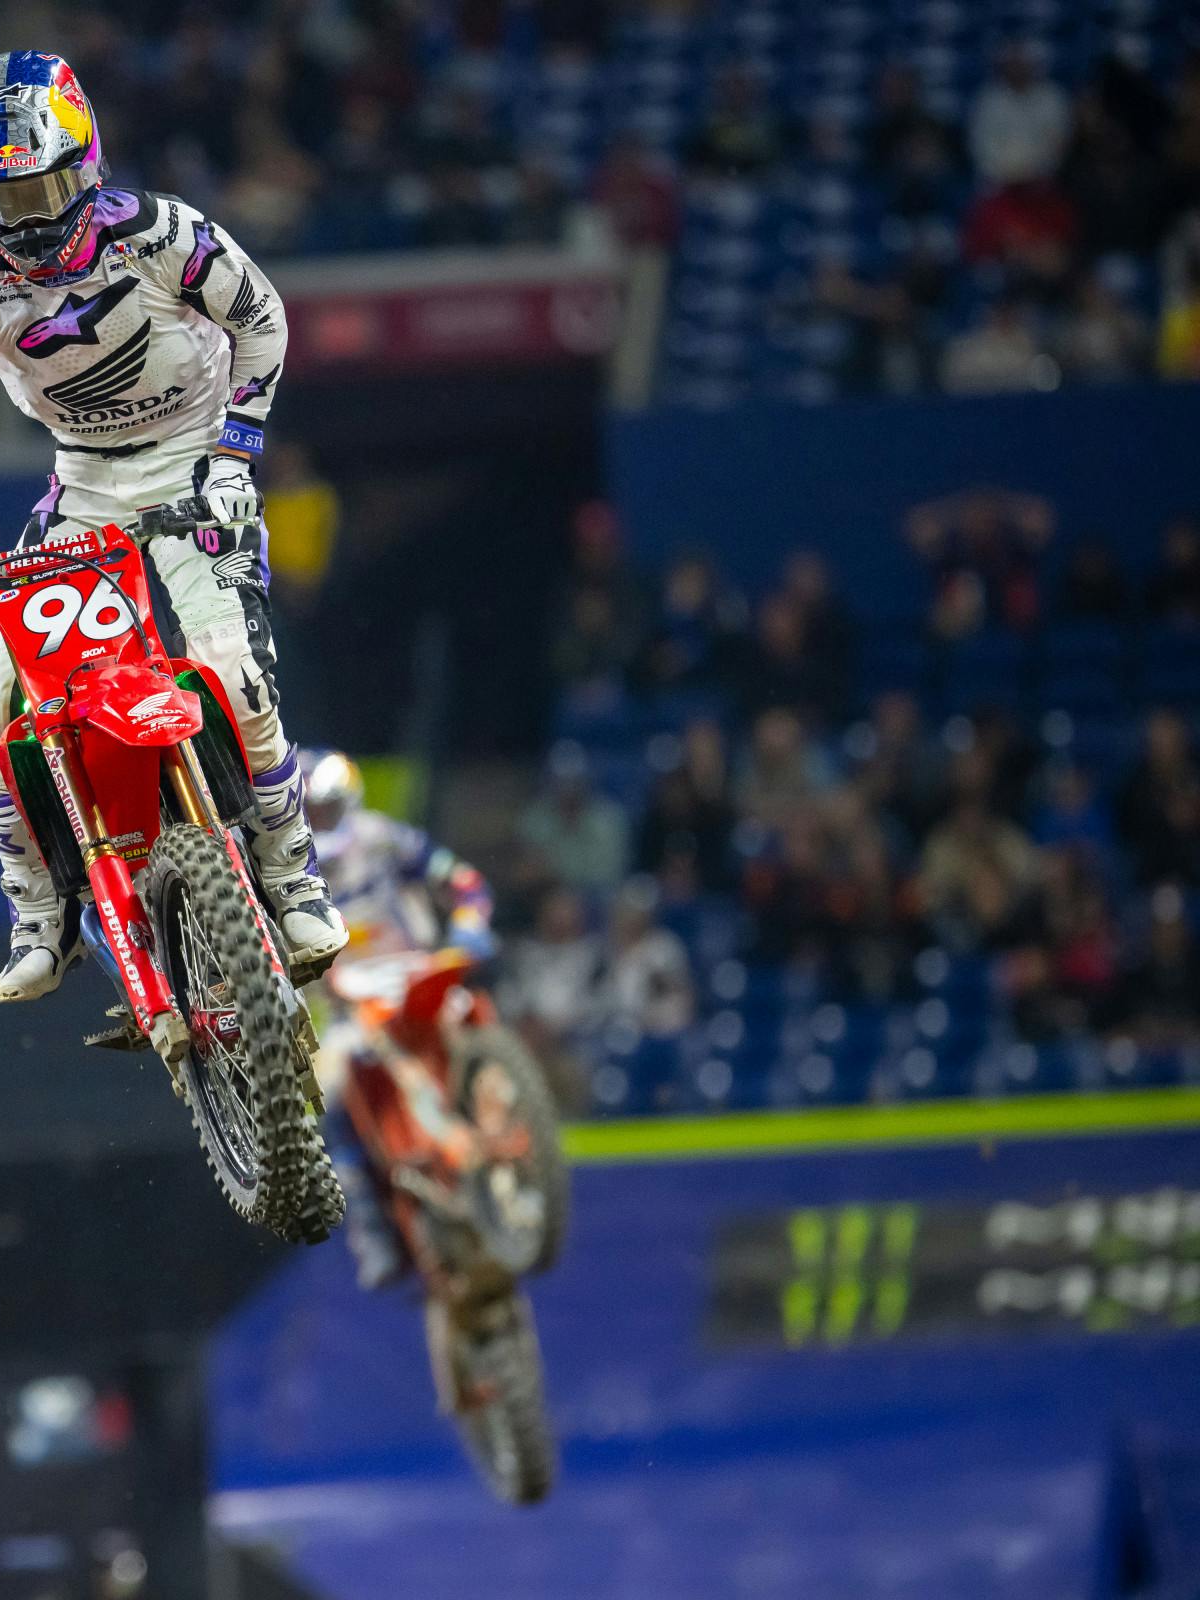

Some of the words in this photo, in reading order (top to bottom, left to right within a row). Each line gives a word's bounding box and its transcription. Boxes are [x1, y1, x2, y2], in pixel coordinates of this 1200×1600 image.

[10, 156, 37, 168] Bull
[234, 293, 271, 330] HONDA
[54, 385, 188, 425] HONDA
[6, 533, 92, 559] RENTHAL
[10, 542, 96, 570] RENHAL
[220, 577, 266, 588] HONDA
[21, 570, 138, 659] 96
[81, 646, 107, 659] SKDA
[131, 708, 187, 725] HONDA
[100, 898, 146, 998] DUNLOP
